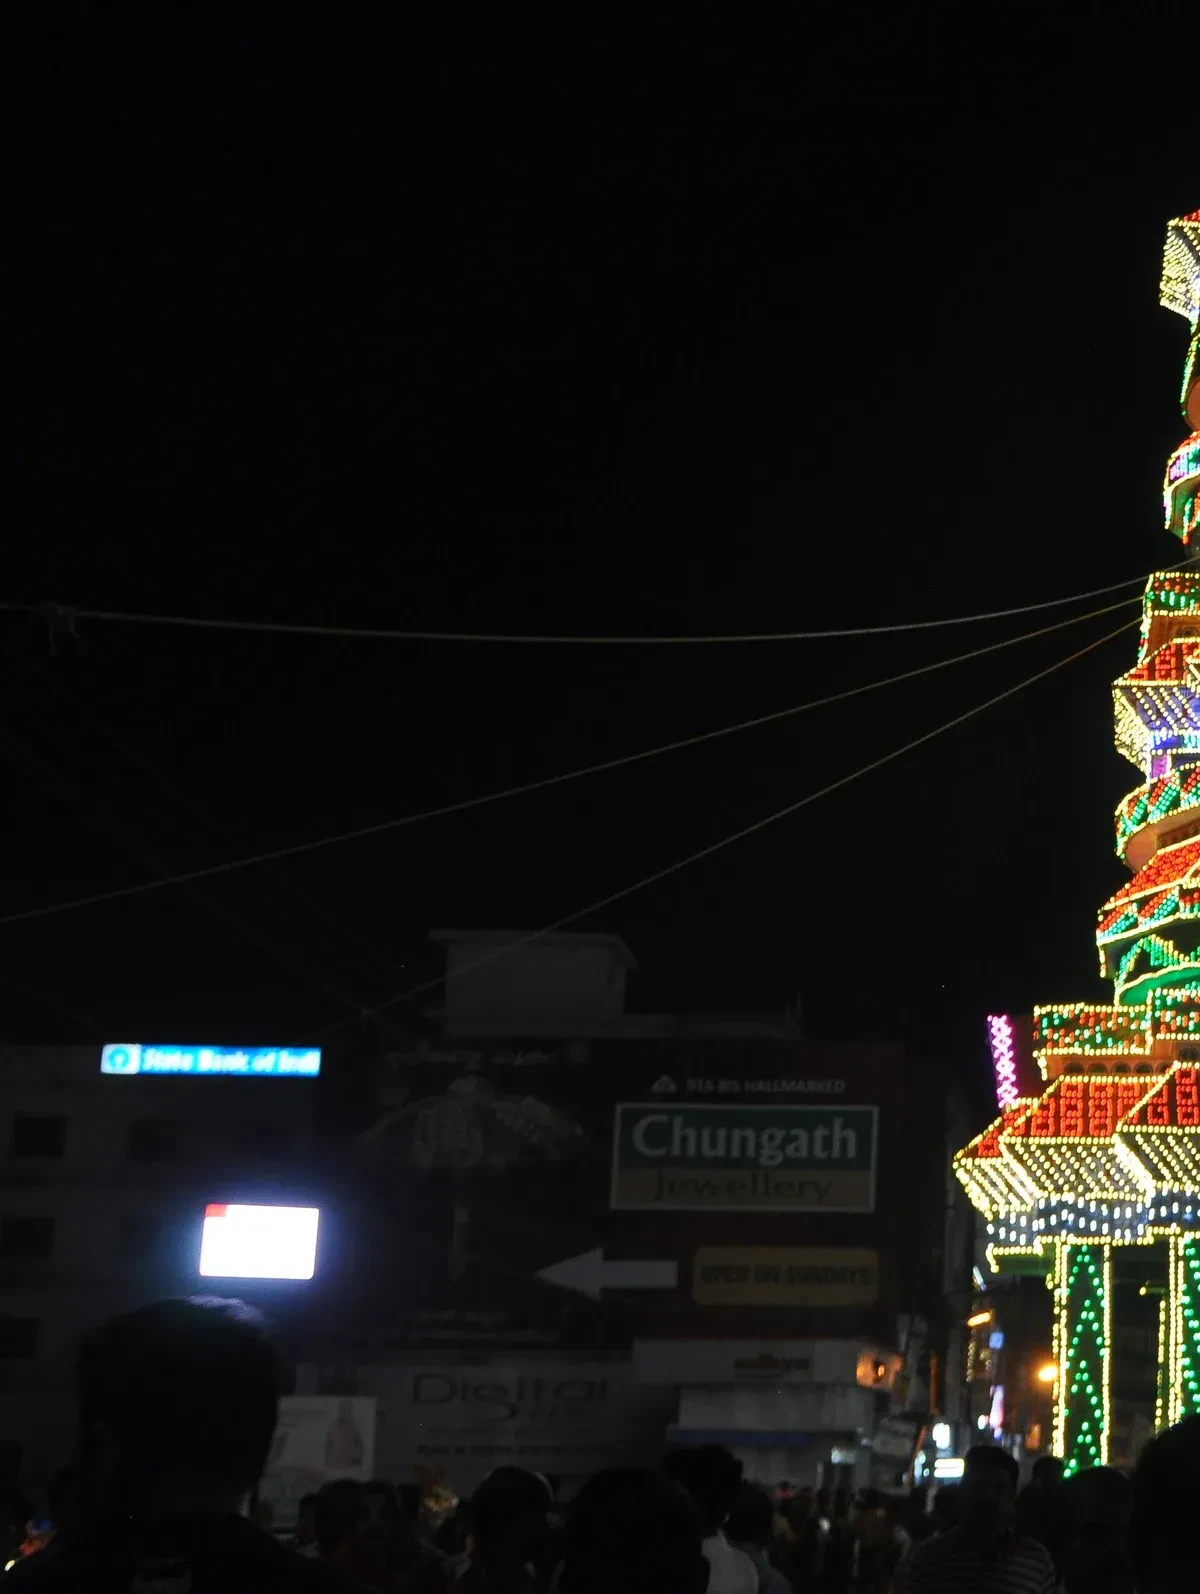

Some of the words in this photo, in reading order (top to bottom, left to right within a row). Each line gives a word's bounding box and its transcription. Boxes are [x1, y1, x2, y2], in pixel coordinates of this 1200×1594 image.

[143, 1048, 194, 1071] State
[198, 1049, 248, 1072] Bank
[252, 1052, 277, 1072] of
[743, 1078, 846, 1094] HALLMARKED
[632, 1113, 858, 1167] Chungath
[653, 1170, 833, 1202] Jewellery
[700, 1263, 750, 1285] OPEN
[753, 1263, 780, 1285] ON
[784, 1264, 873, 1287] SUNDAYS
[412, 1372, 609, 1422] Digital
